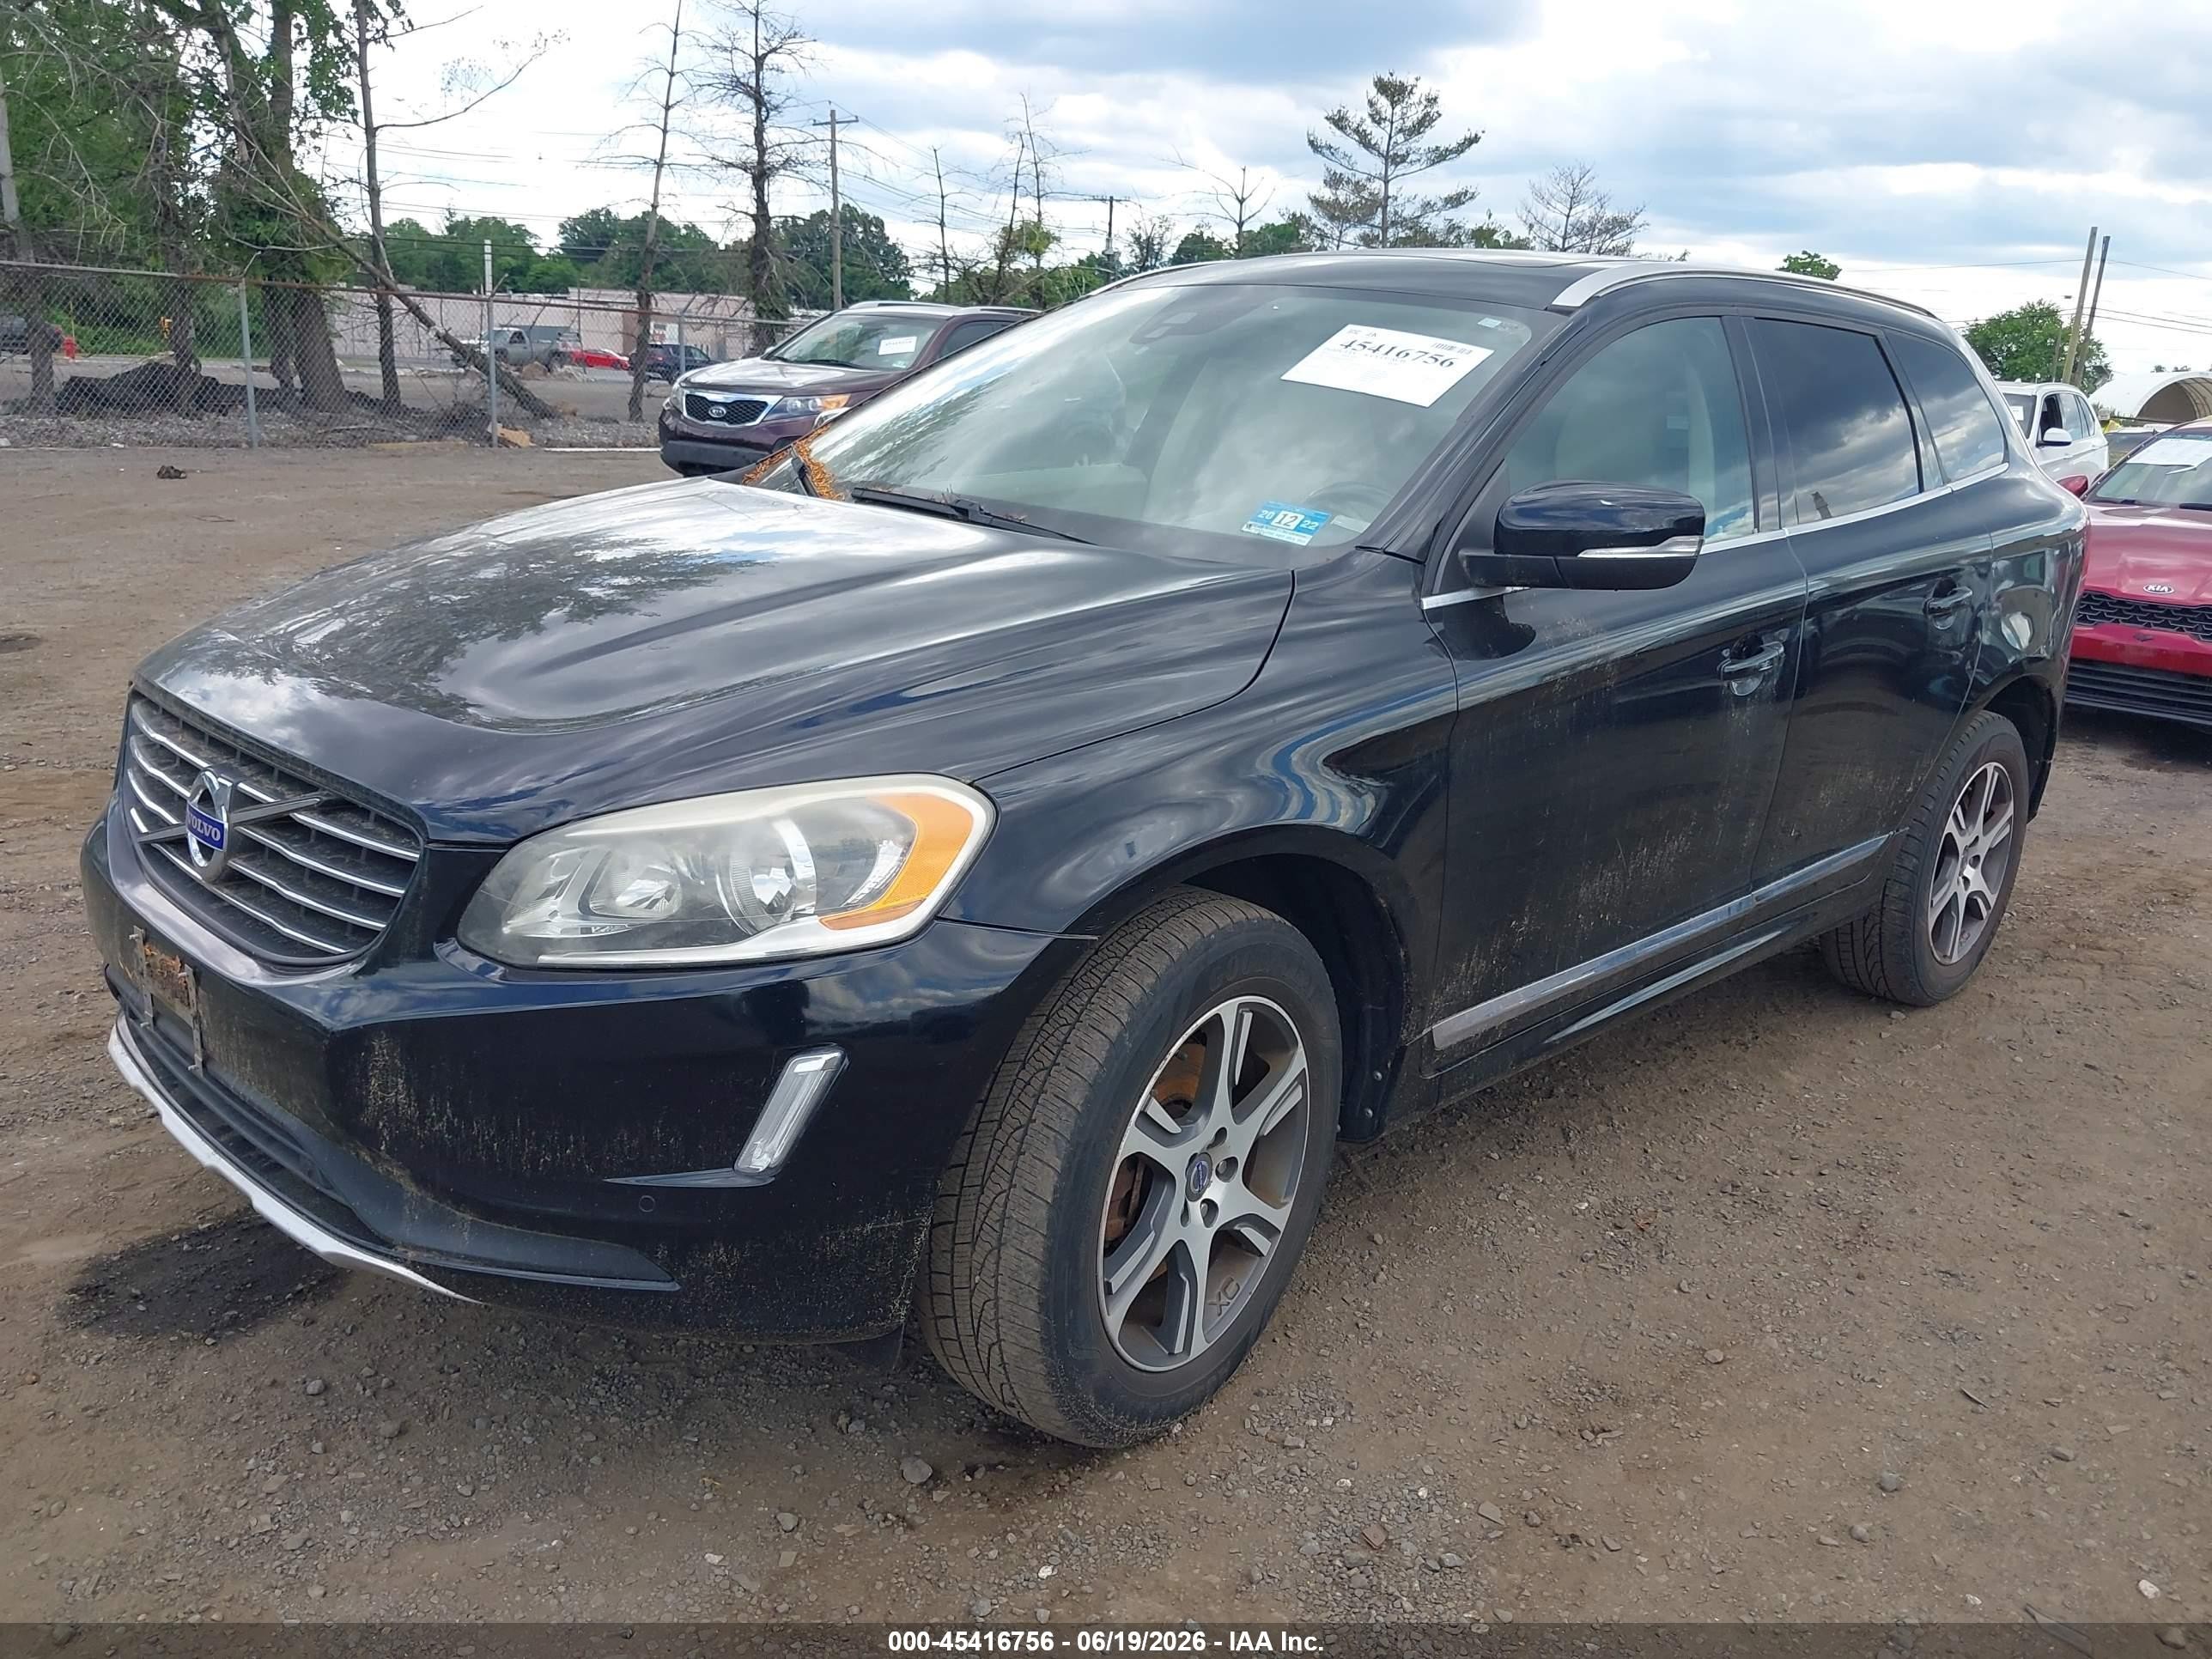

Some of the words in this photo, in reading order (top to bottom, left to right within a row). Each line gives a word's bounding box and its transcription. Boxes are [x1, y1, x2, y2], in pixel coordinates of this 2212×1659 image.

[1340, 339, 1458, 368] 45416756
[1274, 514, 1298, 527] 12
[1300, 520, 1319, 530] 22
[187, 812, 222, 842] VOLVO
[1208, 1276, 1241, 1316] XC
